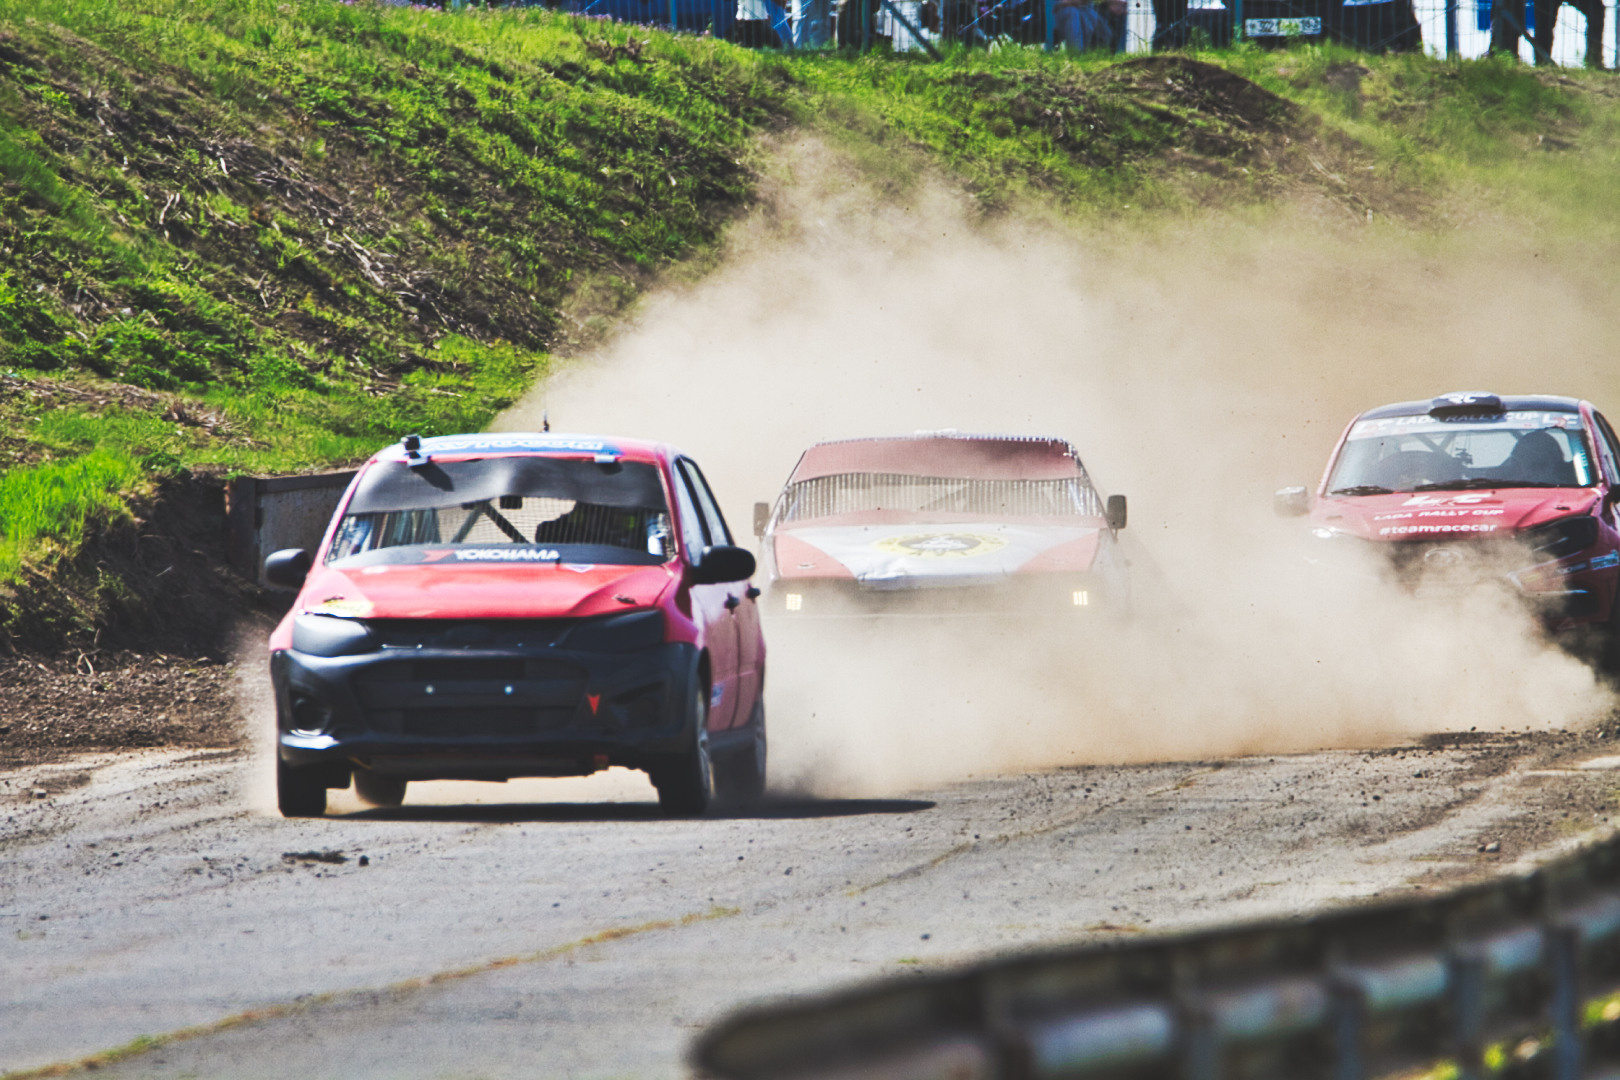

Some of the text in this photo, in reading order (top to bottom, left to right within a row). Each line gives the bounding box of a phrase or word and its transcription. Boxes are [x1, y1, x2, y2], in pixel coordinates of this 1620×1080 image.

[1395, 415, 1438, 426] LADA
[1445, 413, 1502, 423] RALLY
[1504, 411, 1539, 421] CUP
[1373, 512, 1413, 521] LADA
[1379, 523, 1498, 536] #teamracecar
[454, 548, 561, 560] YOKOHAMA
